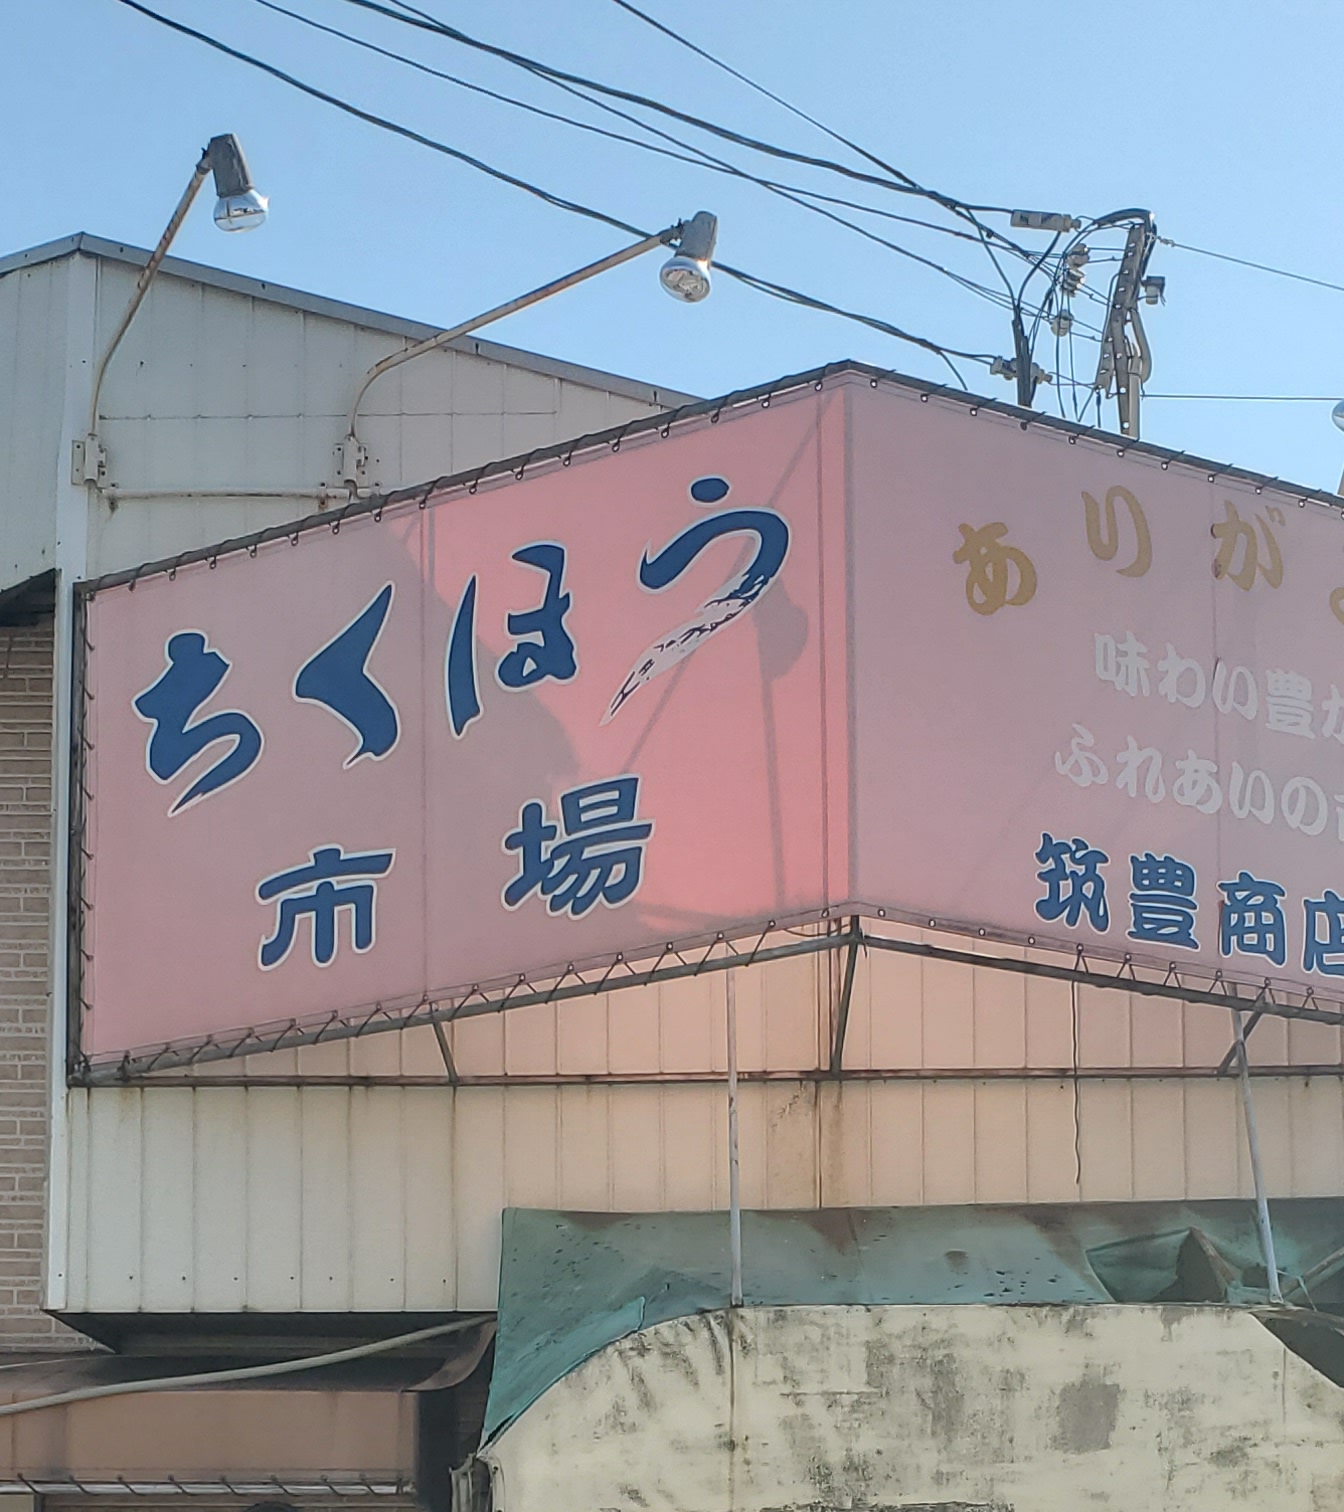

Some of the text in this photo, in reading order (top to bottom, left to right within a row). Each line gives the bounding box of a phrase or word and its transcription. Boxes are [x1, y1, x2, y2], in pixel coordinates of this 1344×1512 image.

[134, 476, 791, 816] ちくほう
[256, 776, 653, 970] 市場
